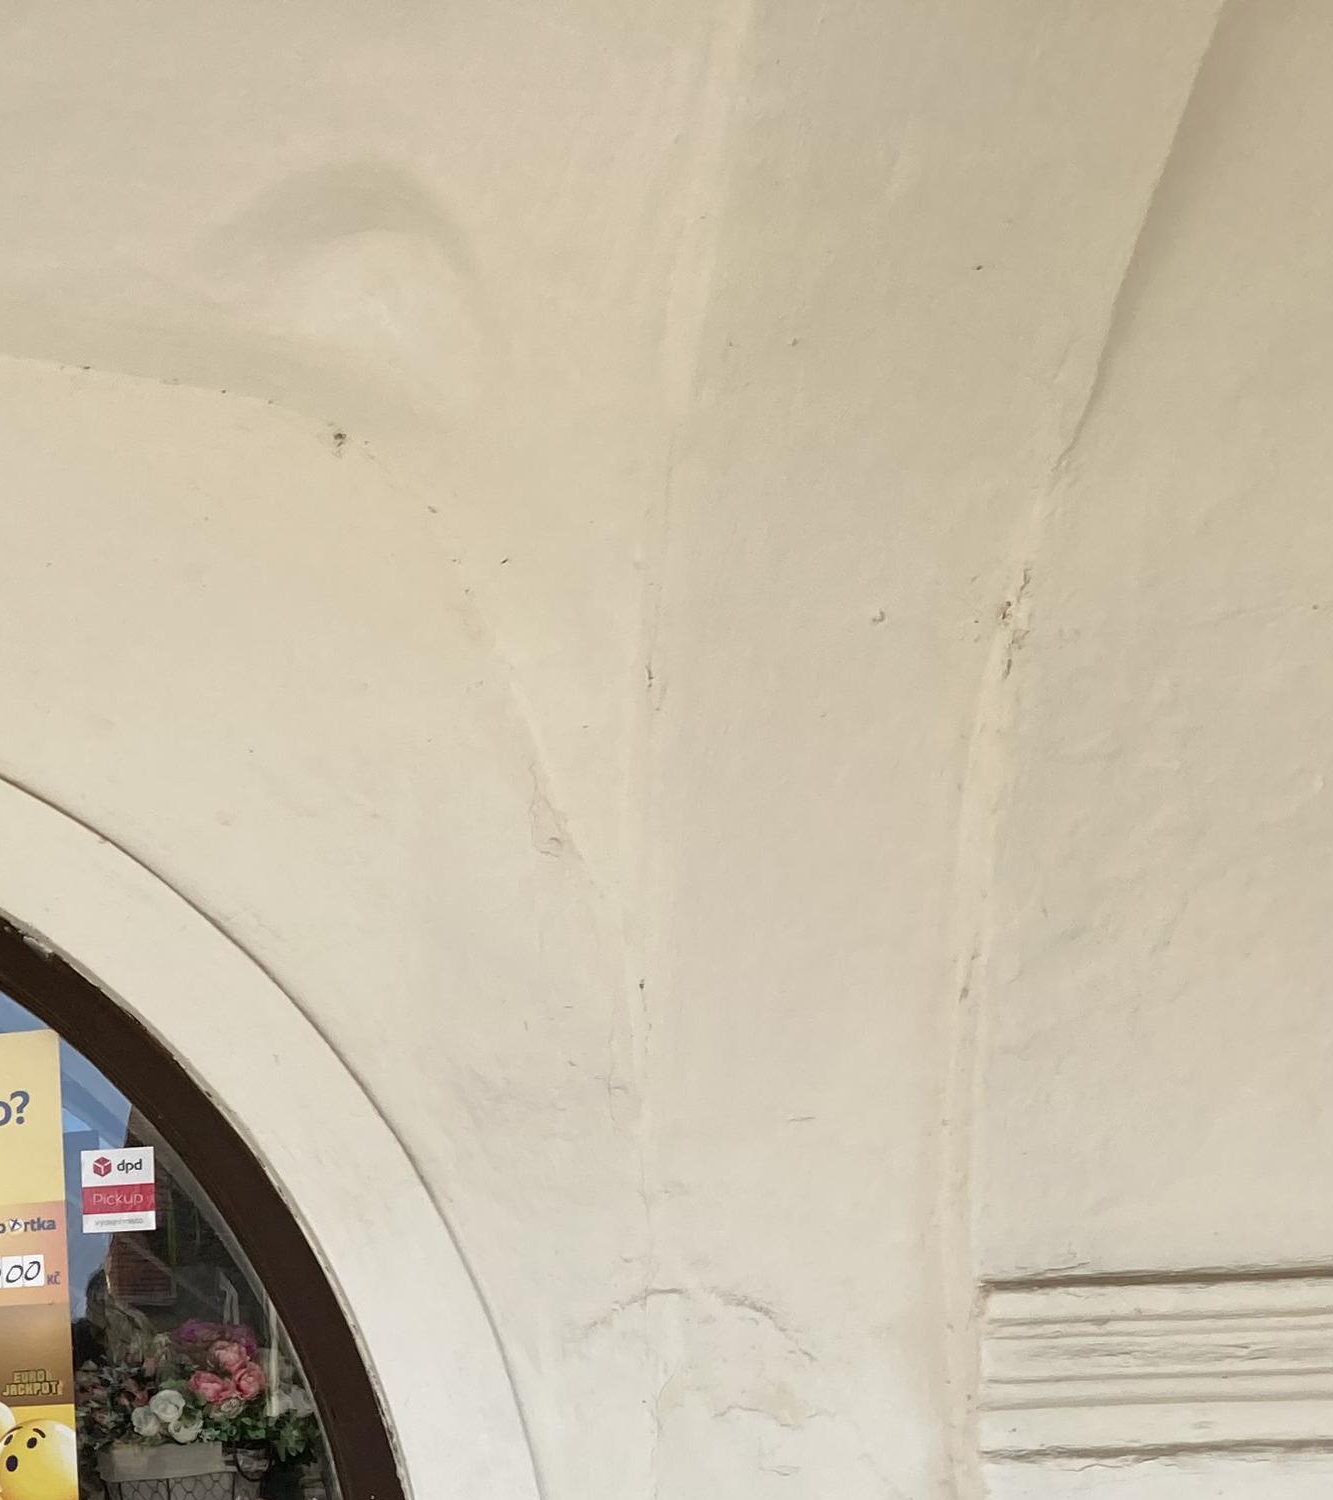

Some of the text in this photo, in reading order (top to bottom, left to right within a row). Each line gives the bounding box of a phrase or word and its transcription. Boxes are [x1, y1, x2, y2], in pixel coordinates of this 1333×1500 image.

[117, 1158, 143, 1174] dpd
[93, 1191, 144, 1206] Pickup
[12, 1369, 47, 1384] EURO
[2, 1380, 60, 1397] JACKPOT
